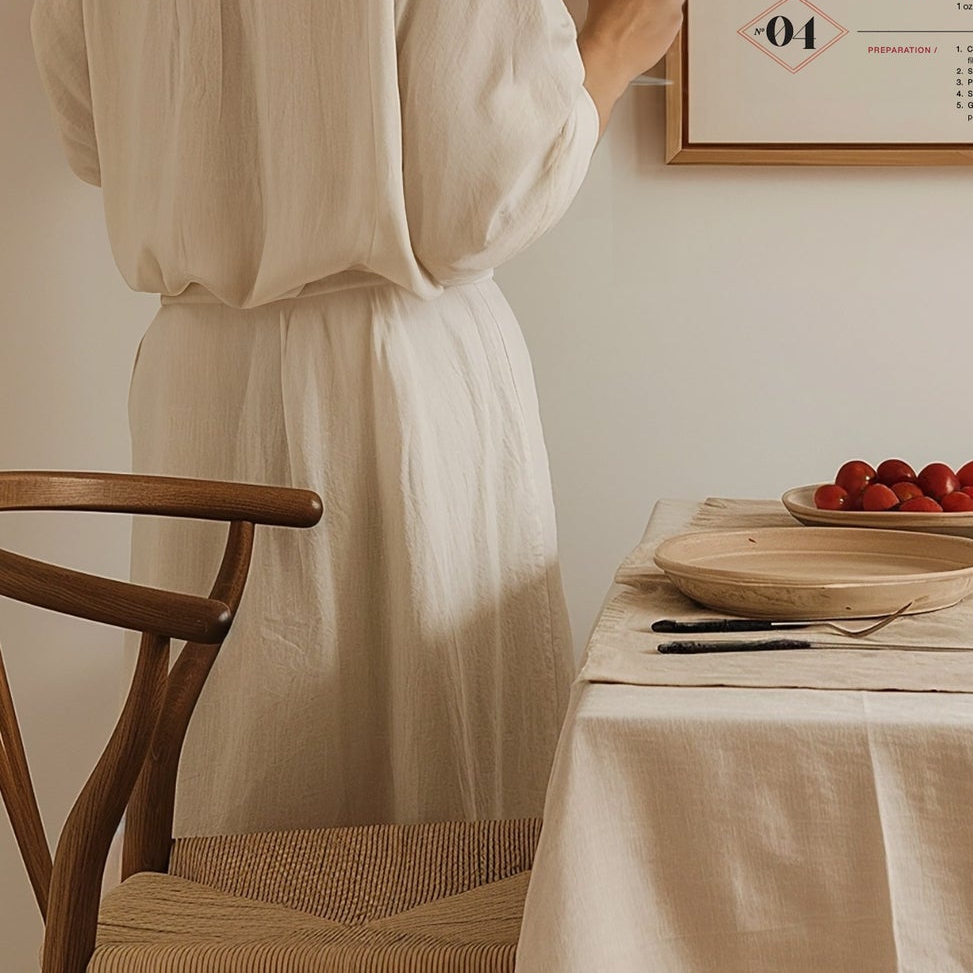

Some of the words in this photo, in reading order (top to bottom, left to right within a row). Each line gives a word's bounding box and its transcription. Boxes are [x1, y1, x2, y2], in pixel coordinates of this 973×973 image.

[957, 2, 960, 10] 1
[766, 15, 816, 49] 04
[868, 46, 931, 54] PREPARATION
[956, 45, 962, 53] 1.
[956, 101, 963, 109] 5.
